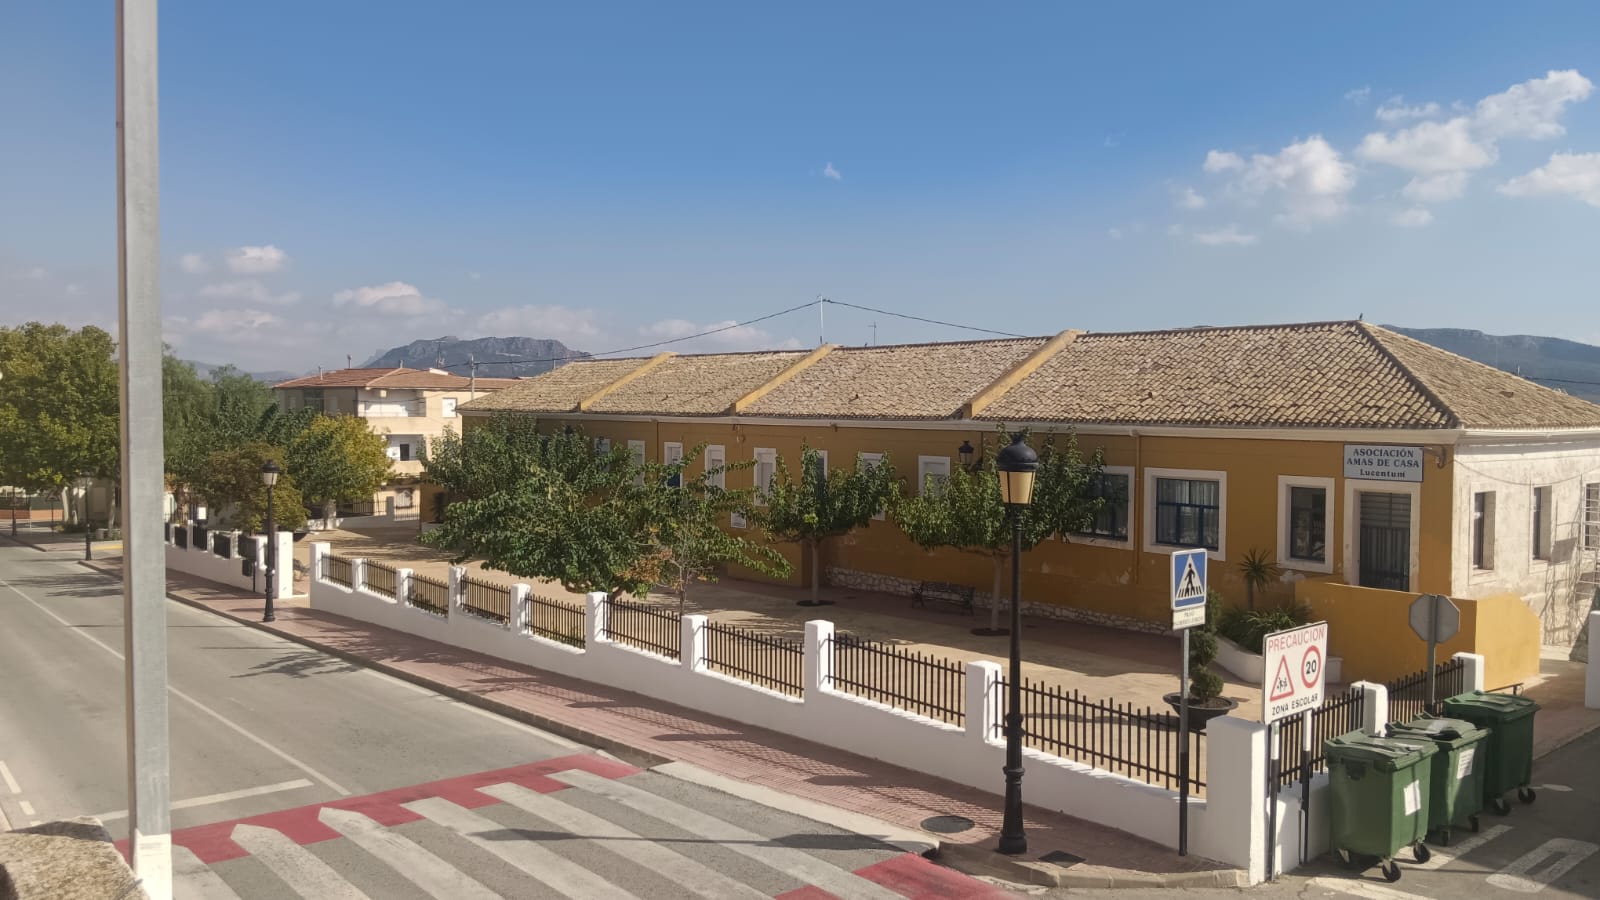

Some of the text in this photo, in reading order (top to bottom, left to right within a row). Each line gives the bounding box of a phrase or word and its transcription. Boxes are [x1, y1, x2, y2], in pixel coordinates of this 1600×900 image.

[1353, 448, 1414, 458] ASOCIACIÓN
[1346, 458, 1420, 468] AMAS DE CASA
[1360, 468, 1406, 478] Lucentum
[1305, 660, 1317, 675] 20
[1272, 693, 1319, 716] ZONA ESCOLAR
